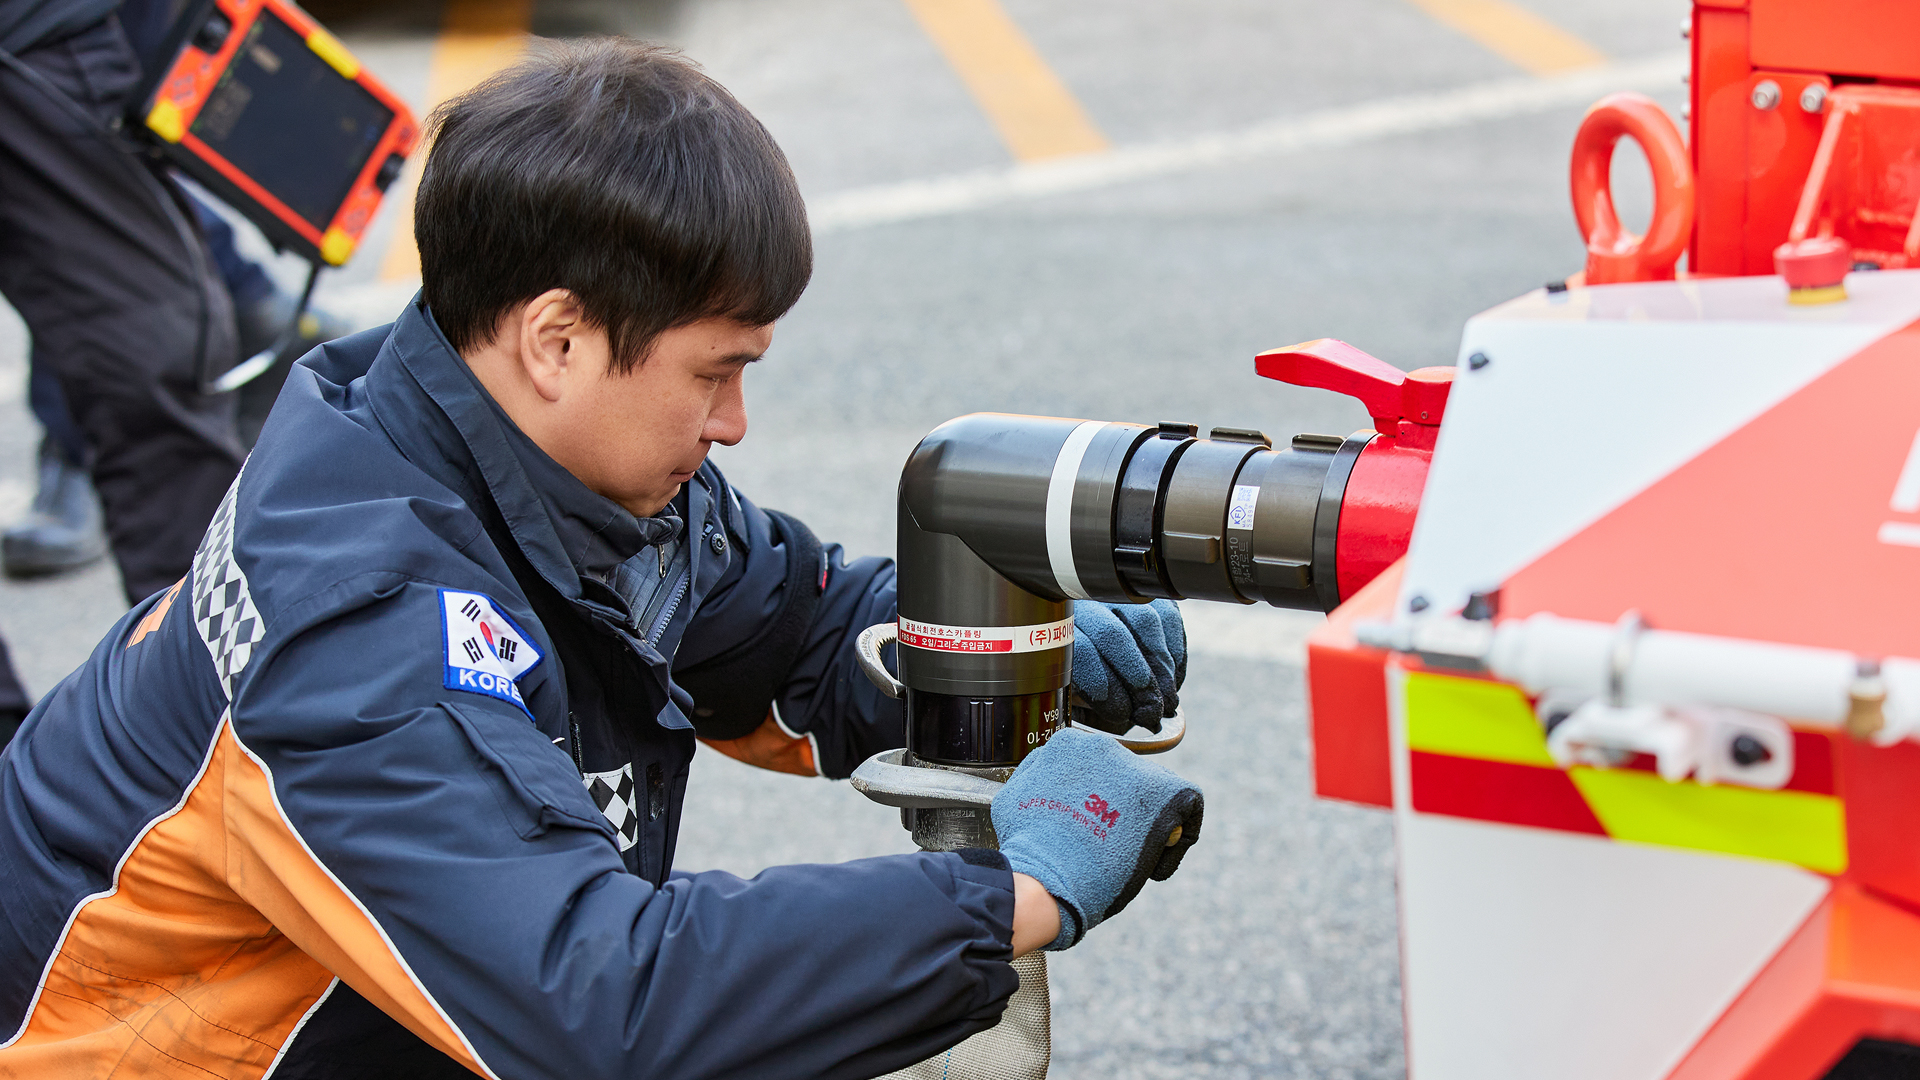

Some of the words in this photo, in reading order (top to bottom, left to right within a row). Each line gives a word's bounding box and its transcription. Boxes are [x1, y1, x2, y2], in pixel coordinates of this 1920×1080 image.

[1234, 509, 1242, 525] KFI
[960, 641, 993, 651] 주입금지
[459, 668, 524, 704] KORE
[1043, 708, 1060, 723] 65A
[1018, 798, 1046, 811] SUPER
[1047, 800, 1072, 814] GRIP
[1072, 808, 1107, 842] WINTER
[1084, 793, 1121, 829] 3M
